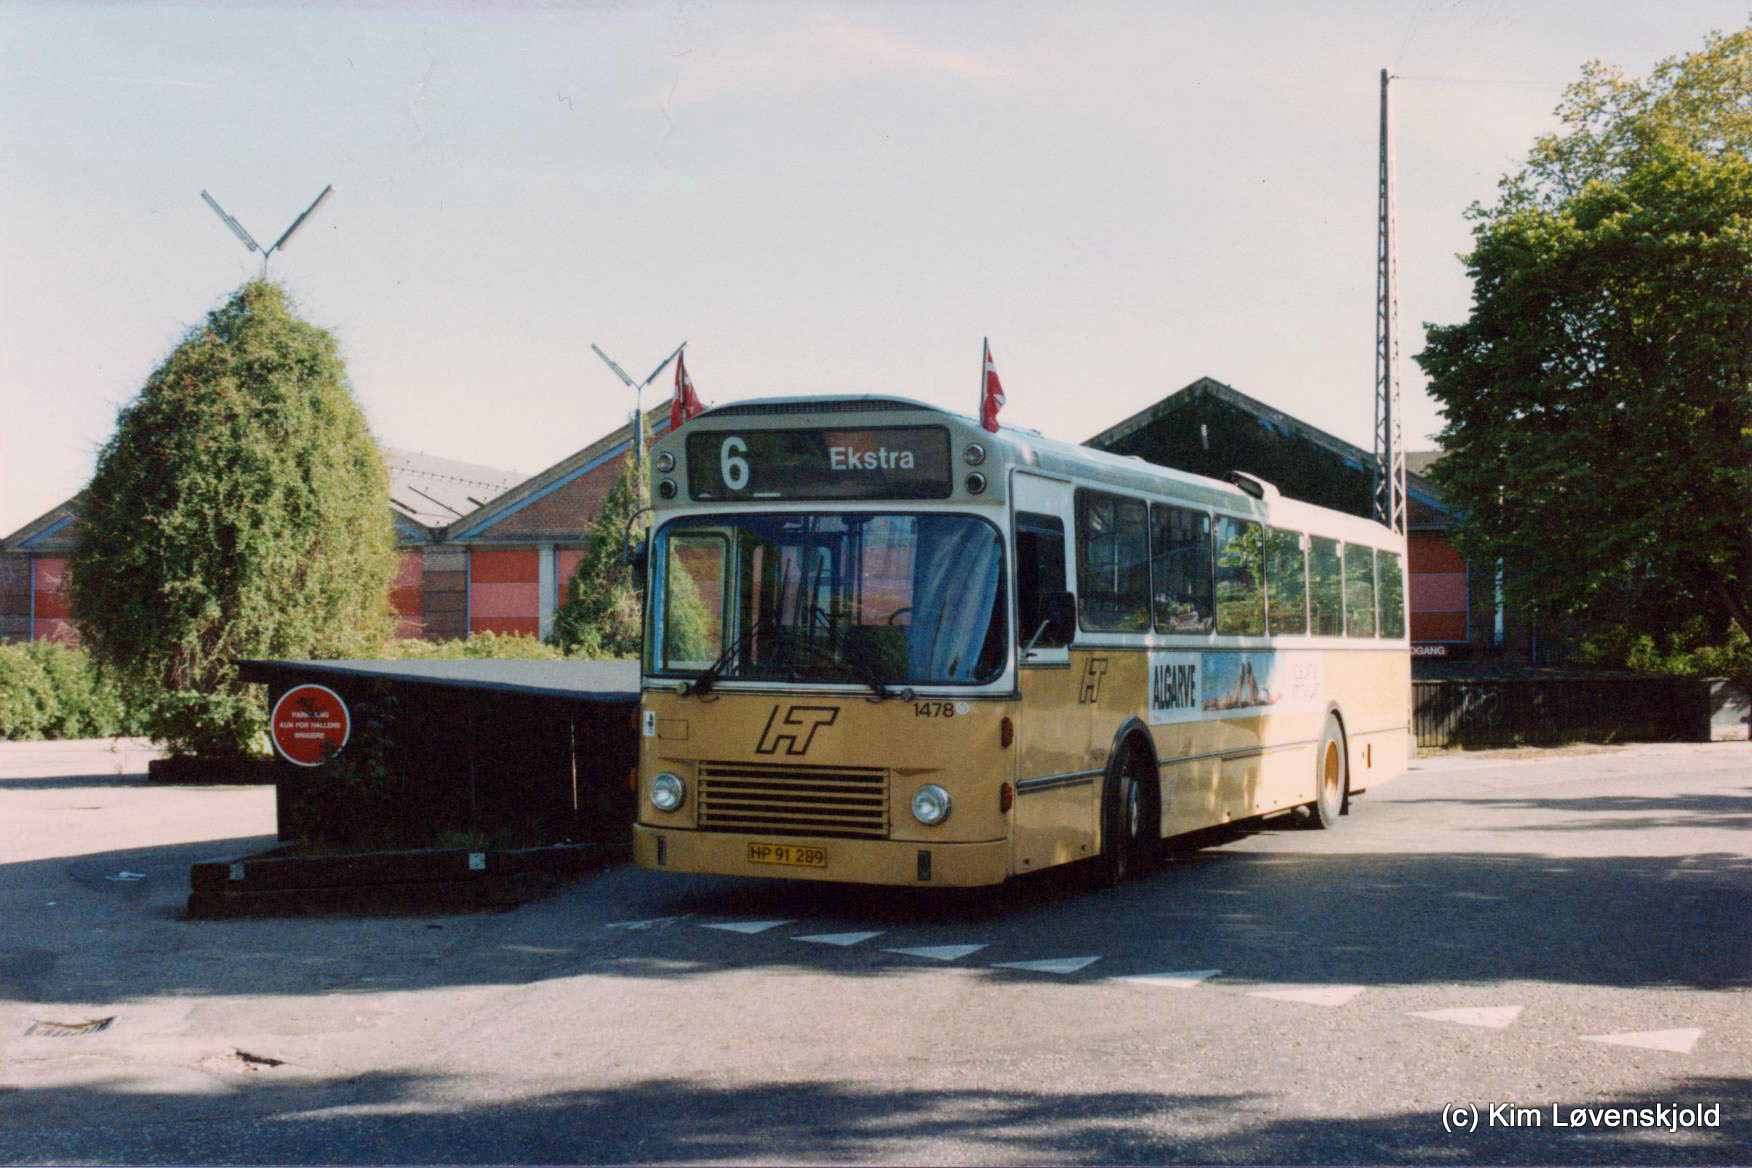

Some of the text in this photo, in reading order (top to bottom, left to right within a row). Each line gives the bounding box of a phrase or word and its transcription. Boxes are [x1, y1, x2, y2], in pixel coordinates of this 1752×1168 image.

[720, 436, 749, 491] 6
[830, 446, 915, 470] Ekstra
[1152, 664, 1196, 711] ALGARVE
[913, 702, 954, 718] 1478
[295, 721, 309, 729] FOR
[750, 845, 824, 864] HP 91 289
